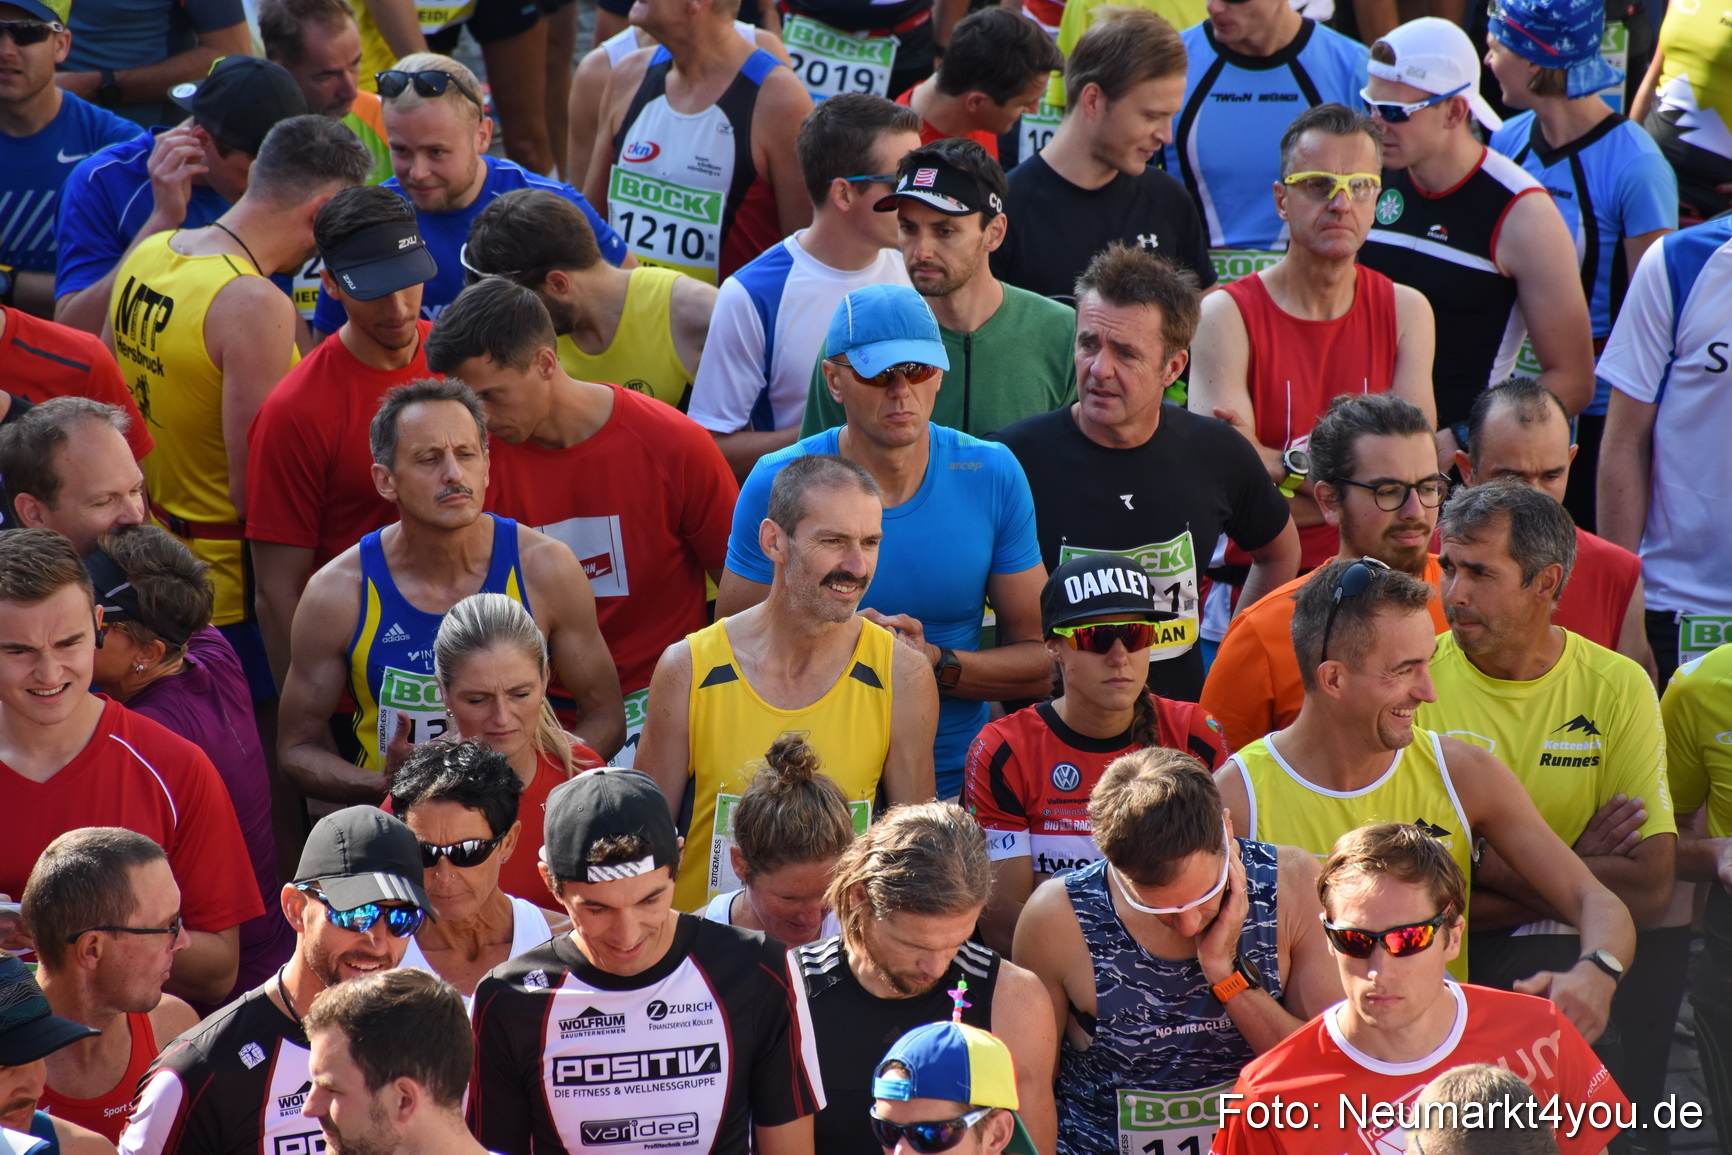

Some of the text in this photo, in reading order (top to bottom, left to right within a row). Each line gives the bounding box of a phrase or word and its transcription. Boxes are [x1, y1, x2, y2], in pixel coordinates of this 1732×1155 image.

[789, 22, 884, 63] BOCK
[617, 172, 711, 220] BOCK
[399, 235, 417, 250] 2XU
[619, 211, 705, 260] 1210
[342, 274, 357, 291] 2XU
[115, 333, 165, 377] Hersbruck
[1064, 567, 1149, 605] OAKLEY
[381, 633, 411, 644] adidas
[669, 1001, 713, 1014] ZURICH
[559, 1015, 626, 1032] WOLFRUM
[1155, 1018, 1232, 1037] NO MIRACLES
[560, 1028, 626, 1040] BAUUNTERNEHMEN
[556, 1047, 715, 1083] POSITIV
[554, 1077, 716, 1098] DIE FITNESS & WELLNESSGRUPPE
[103, 1105, 128, 1118] Sport
[585, 1120, 694, 1142] varidee
[643, 1138, 700, 1150] Profiltechnik GmbH
